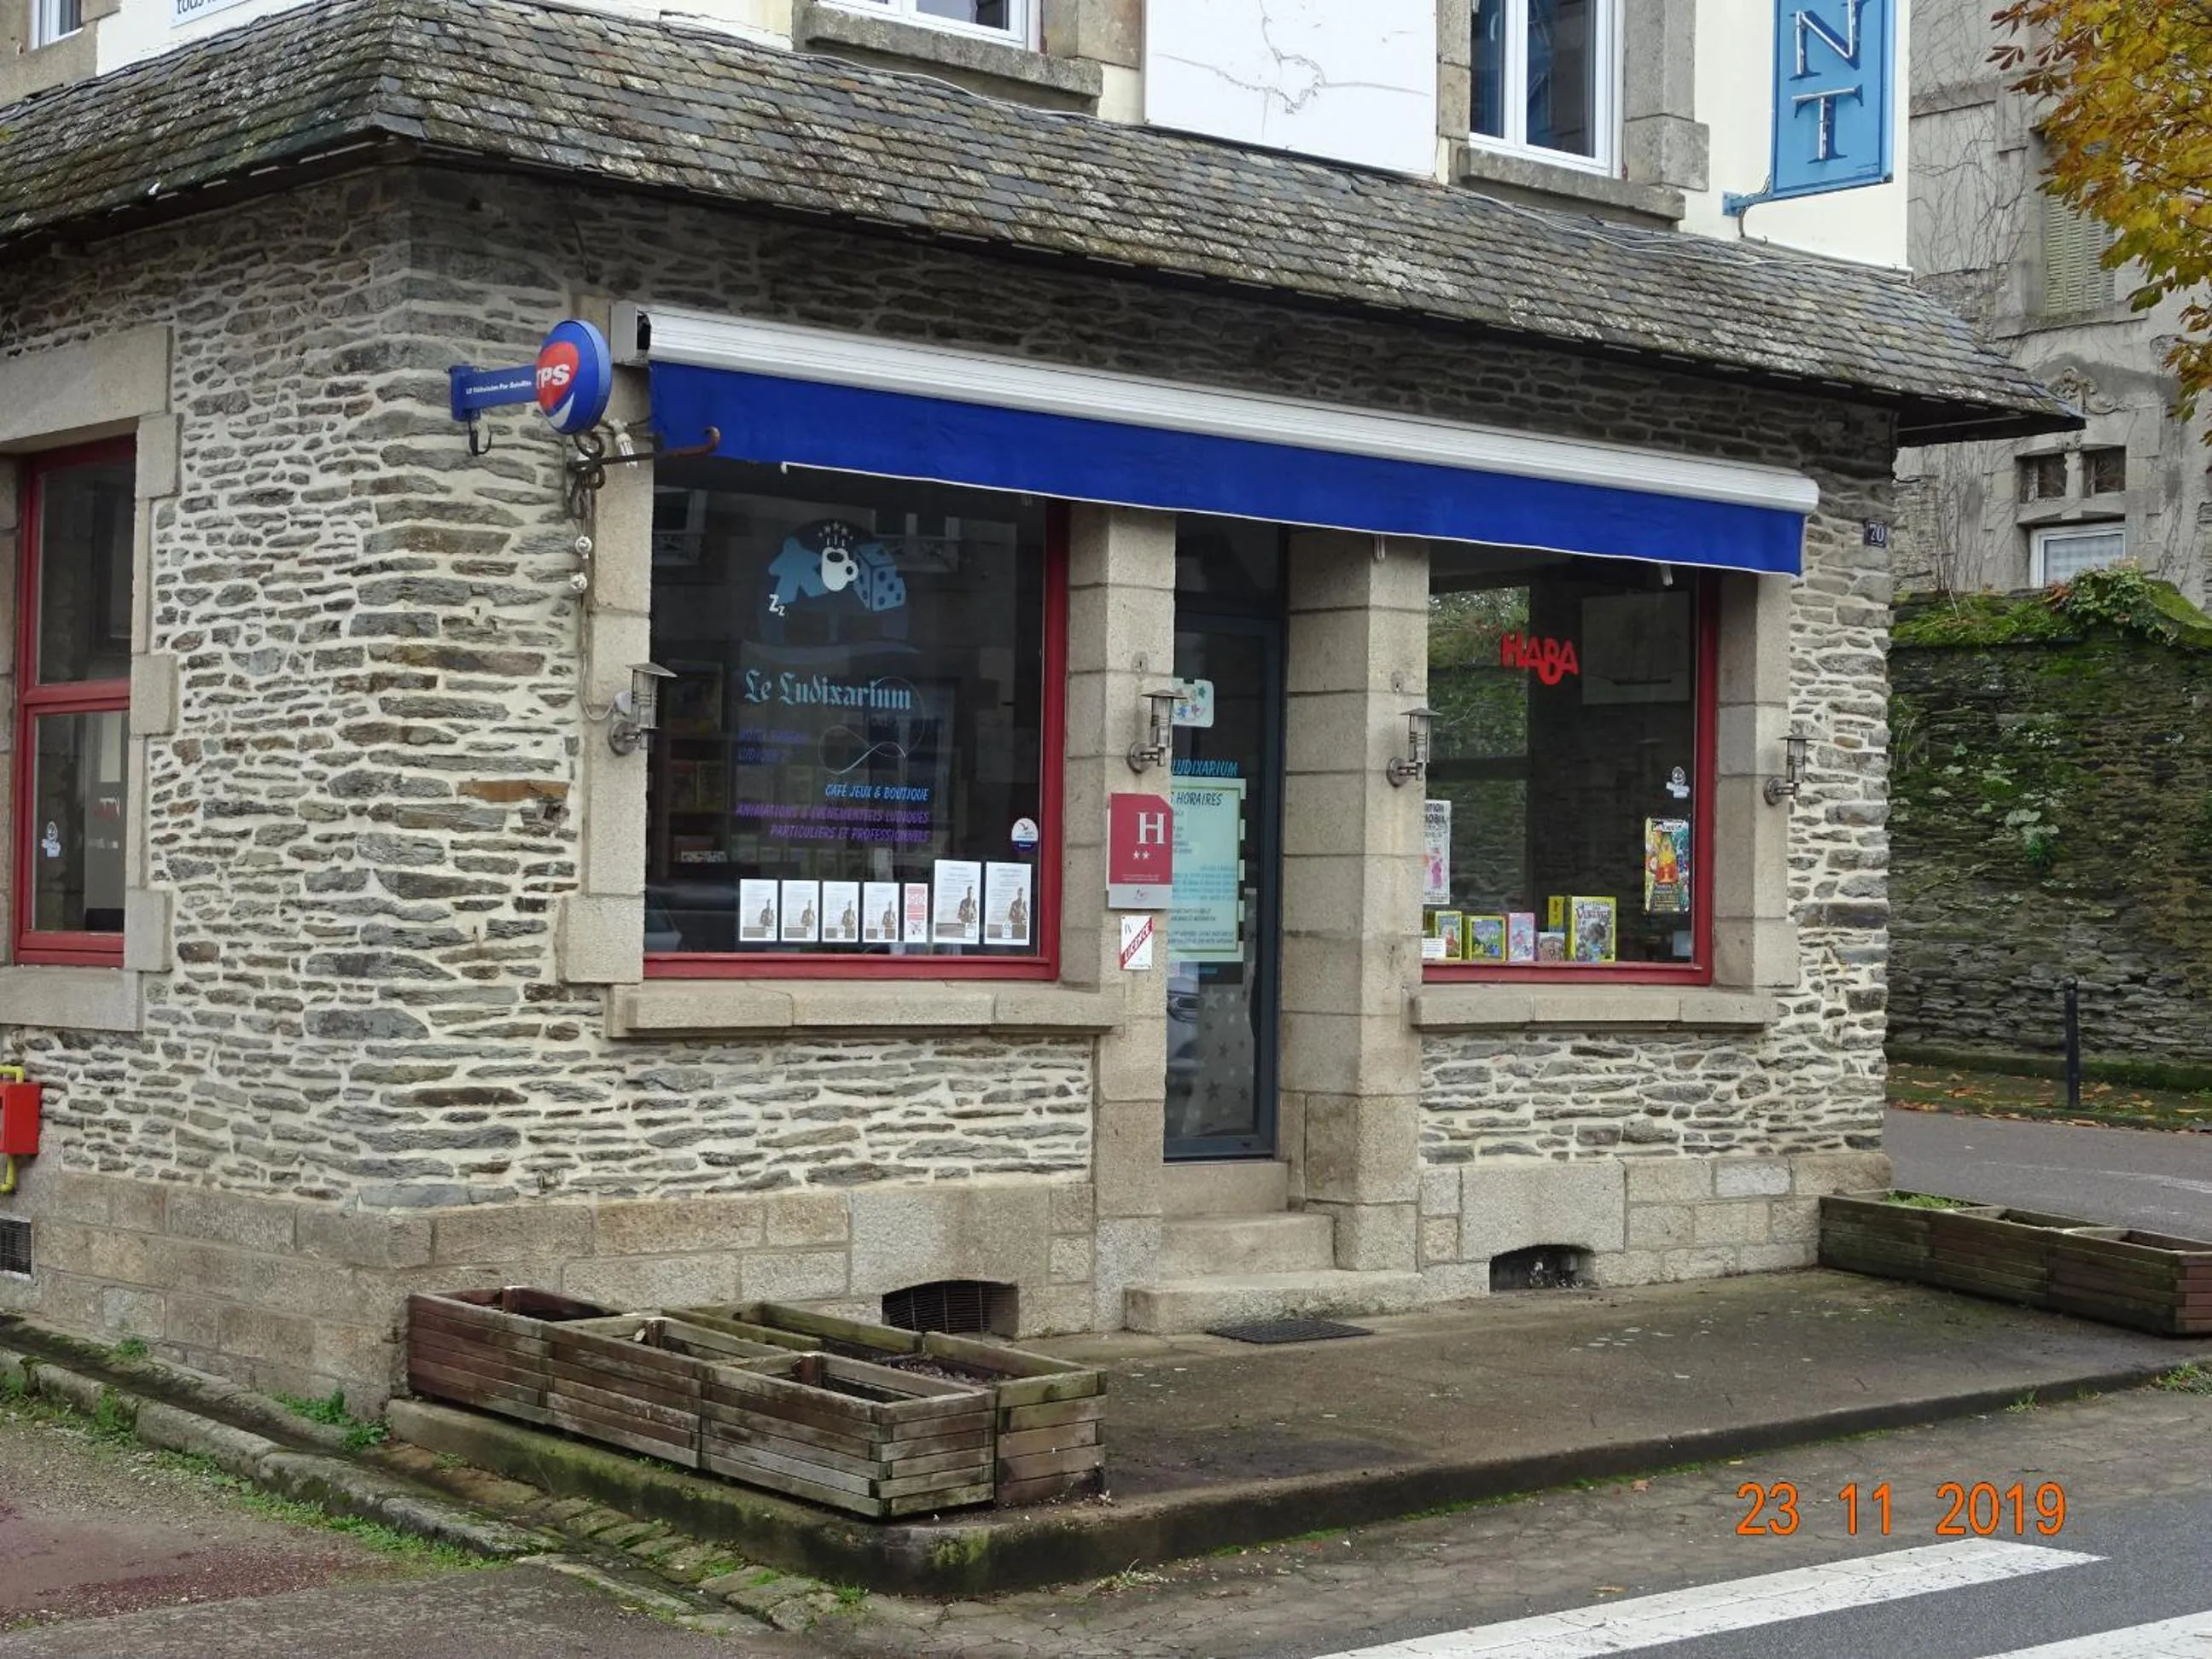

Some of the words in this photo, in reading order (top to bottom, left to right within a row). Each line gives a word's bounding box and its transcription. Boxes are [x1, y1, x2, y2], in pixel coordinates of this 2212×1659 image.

[1500, 628, 1580, 685] HABA
[744, 669, 772, 702] Le
[779, 672, 911, 710] Ludixarium
[825, 782, 847, 798] CAFÉ
[850, 784, 872, 800] JEUX
[884, 786, 929, 802] BOUTIQUE
[1176, 791, 1223, 806] HORAIRES
[1137, 812, 1167, 844] H
